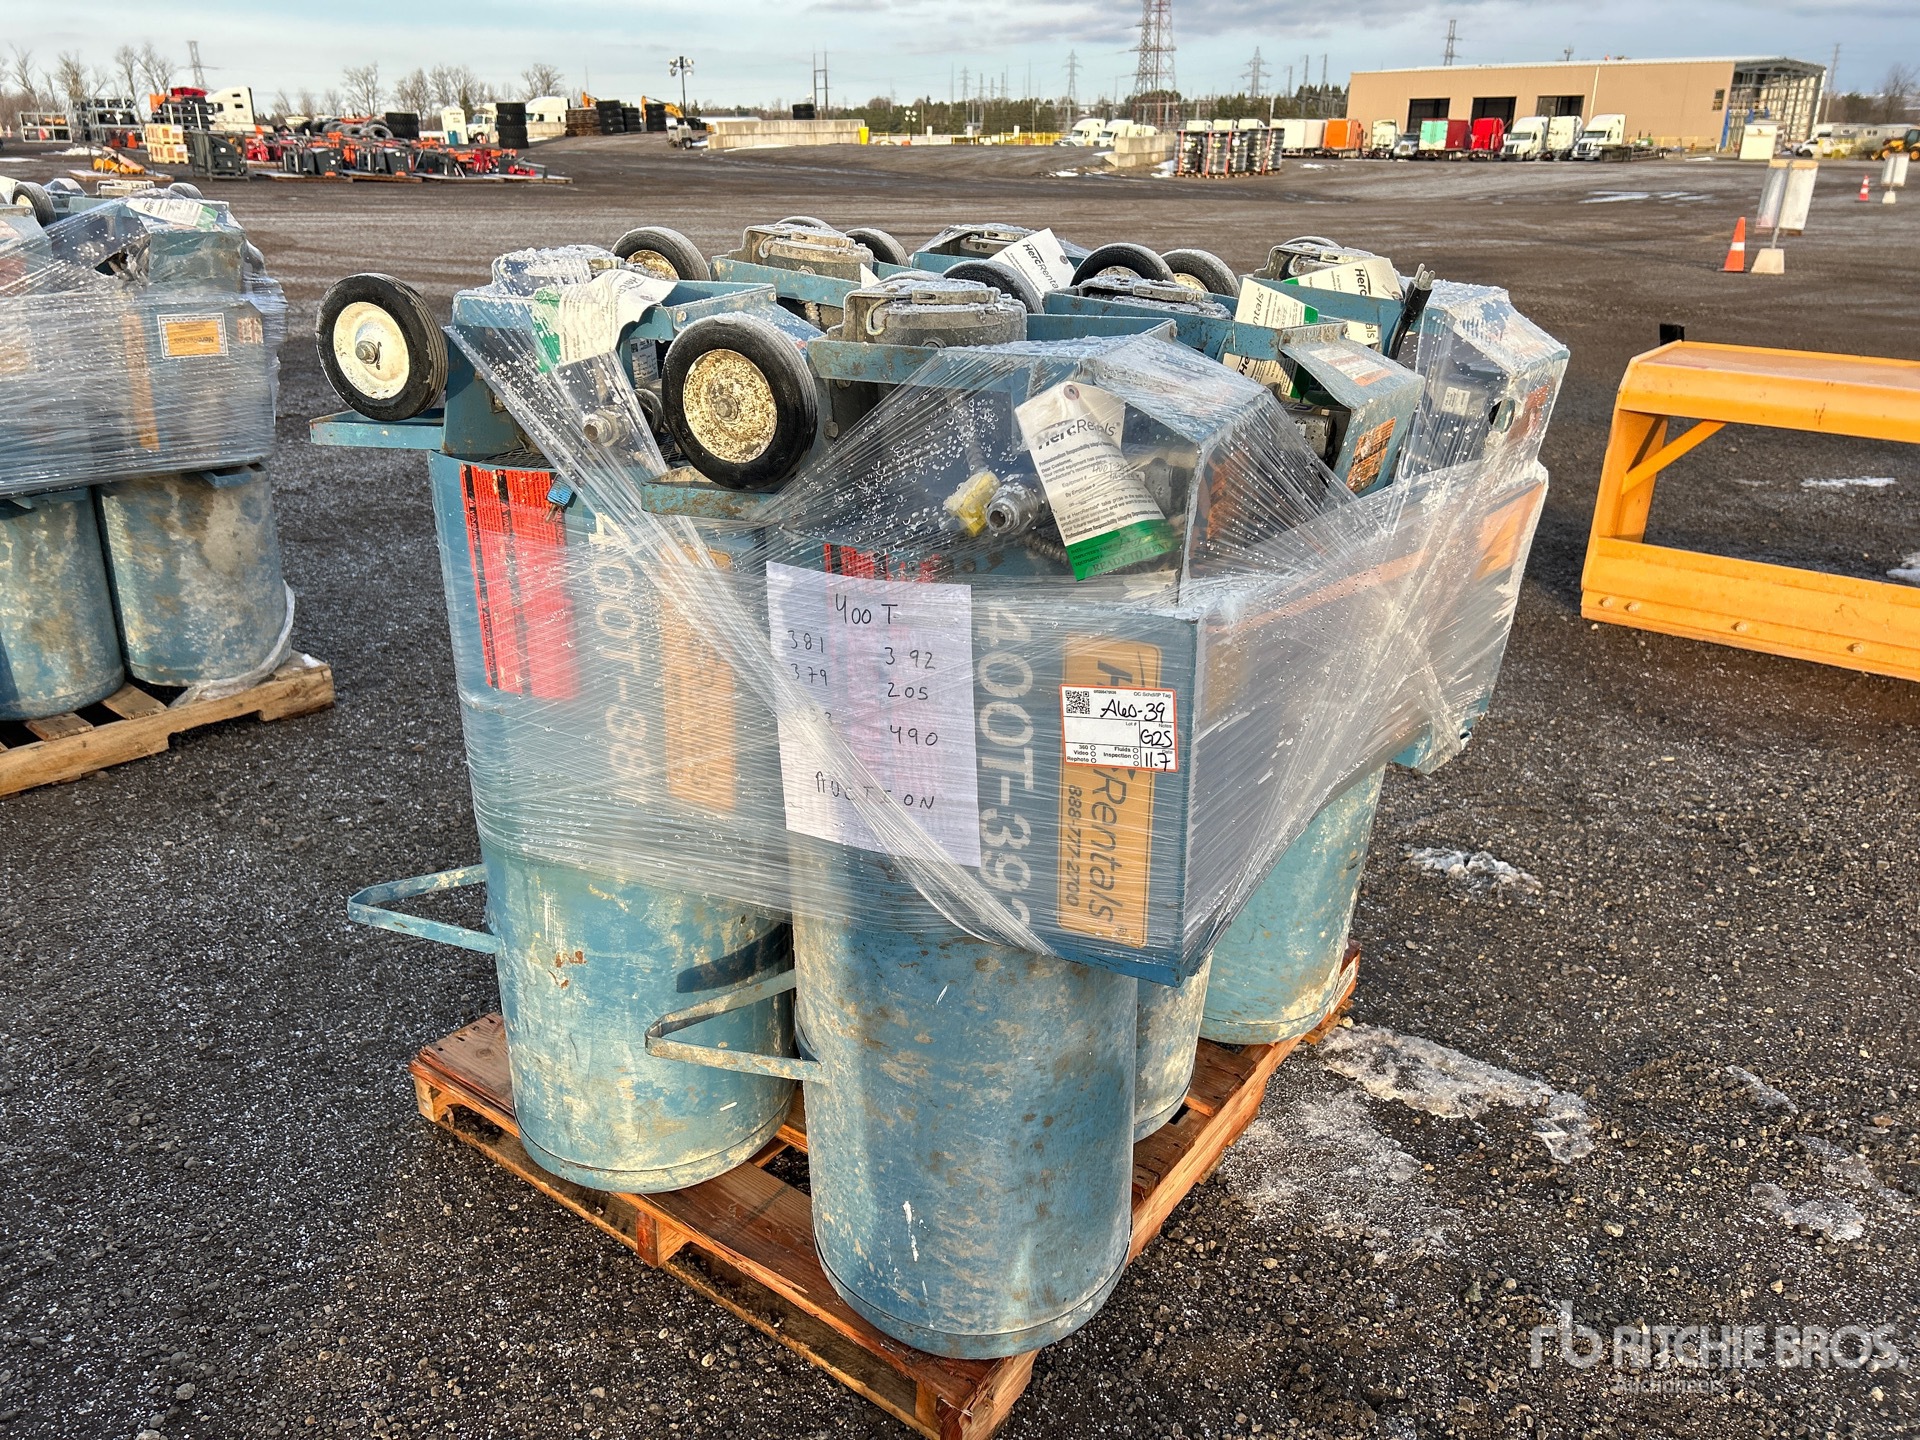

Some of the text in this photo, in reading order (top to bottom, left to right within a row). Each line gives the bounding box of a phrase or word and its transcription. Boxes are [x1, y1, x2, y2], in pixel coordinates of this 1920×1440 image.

[1092, 555, 1125, 571] READY
[835, 593, 899, 625] 400 T
[787, 630, 825, 654] 381
[884, 646, 936, 670] 392
[790, 663, 828, 687] 379
[887, 681, 929, 701] 205
[889, 724, 939, 747] 490
[1145, 751, 1171, 772] 11.7
[1066, 784, 1083, 908] 888-777-2700
